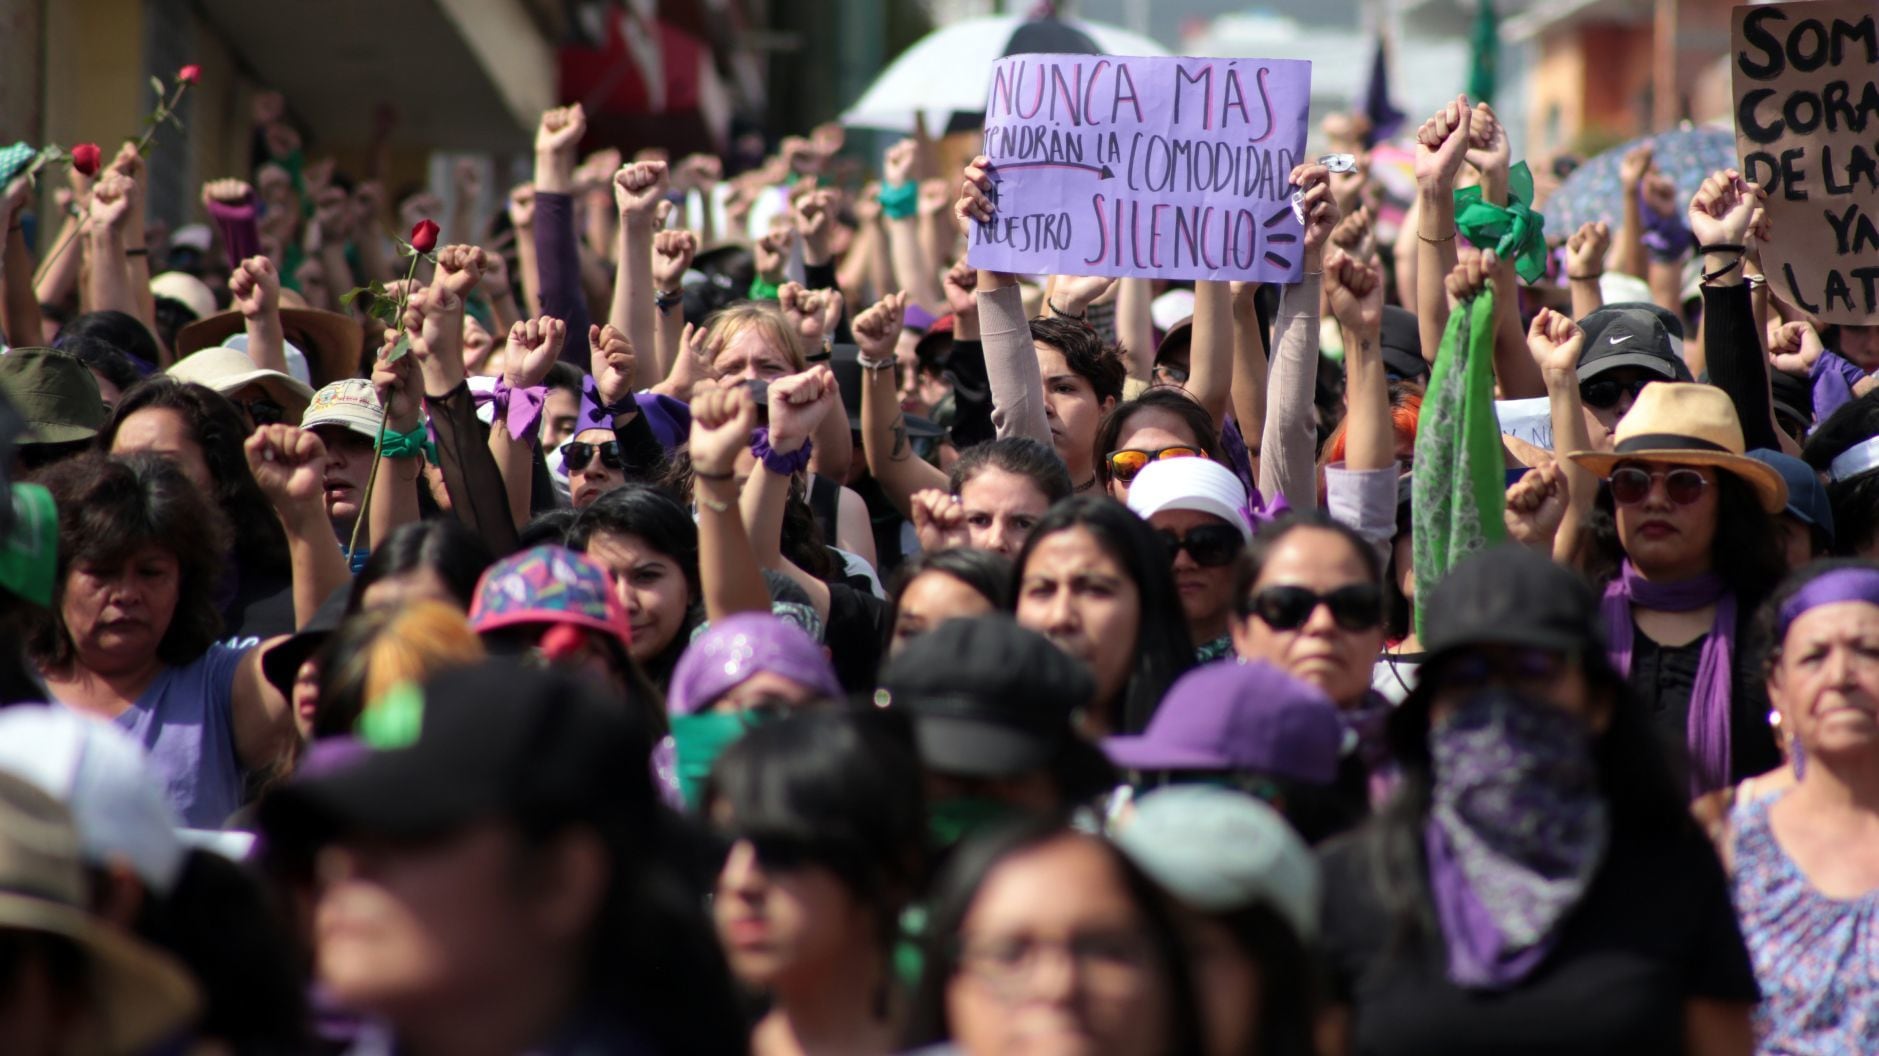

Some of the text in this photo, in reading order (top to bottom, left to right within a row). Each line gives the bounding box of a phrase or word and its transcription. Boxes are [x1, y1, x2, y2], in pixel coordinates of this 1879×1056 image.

[1738, 6, 1879, 80] SOM
[991, 59, 1278, 143] NUNCA MÁS
[1738, 80, 1879, 144] CORA
[1097, 132, 1122, 164] LA
[1127, 131, 1295, 202] COMODIDAD
[1744, 145, 1879, 201] DE LA
[975, 192, 1257, 270] NUESTRO SILENCIO
